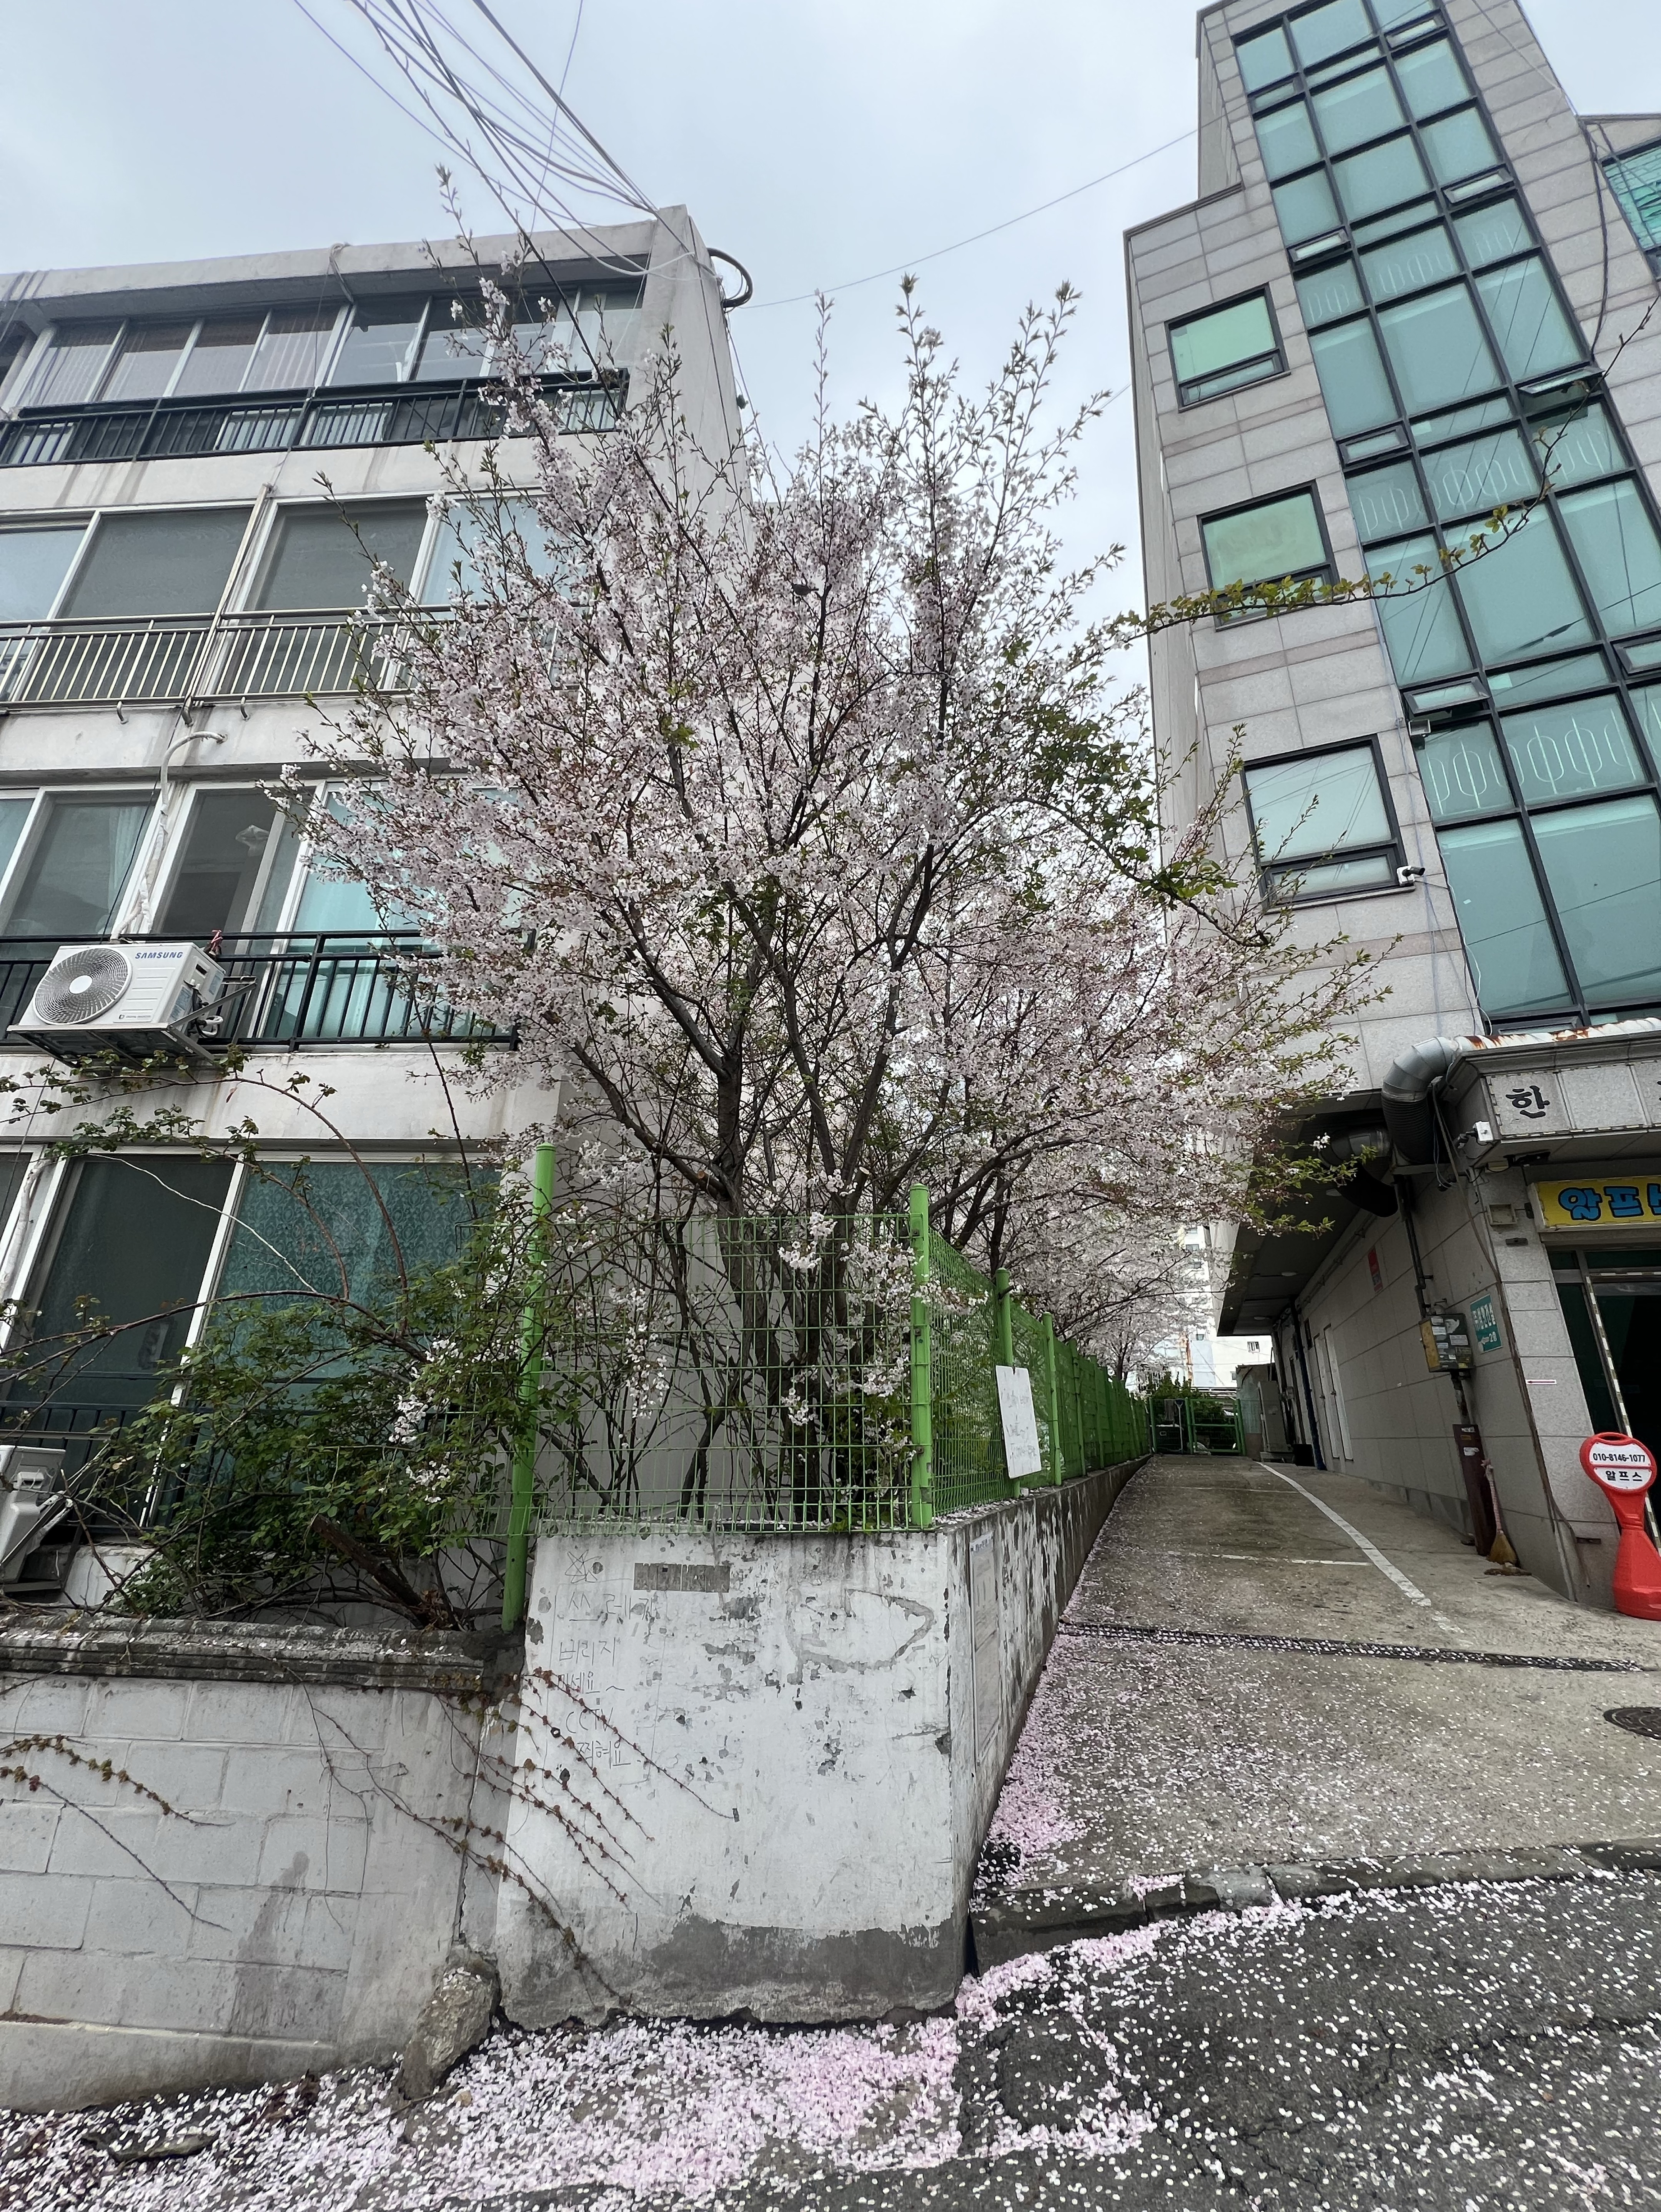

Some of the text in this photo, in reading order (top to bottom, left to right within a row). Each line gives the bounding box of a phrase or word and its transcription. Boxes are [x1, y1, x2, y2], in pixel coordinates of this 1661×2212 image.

[1505, 1085, 1550, 1119] 한
[1593, 1453, 1646, 1462] 010-8146-1077
[1605, 1470, 1643, 1482] 알프스
[559, 1637, 616, 1666] 버리지
[566, 1706, 614, 1733] CCTV
